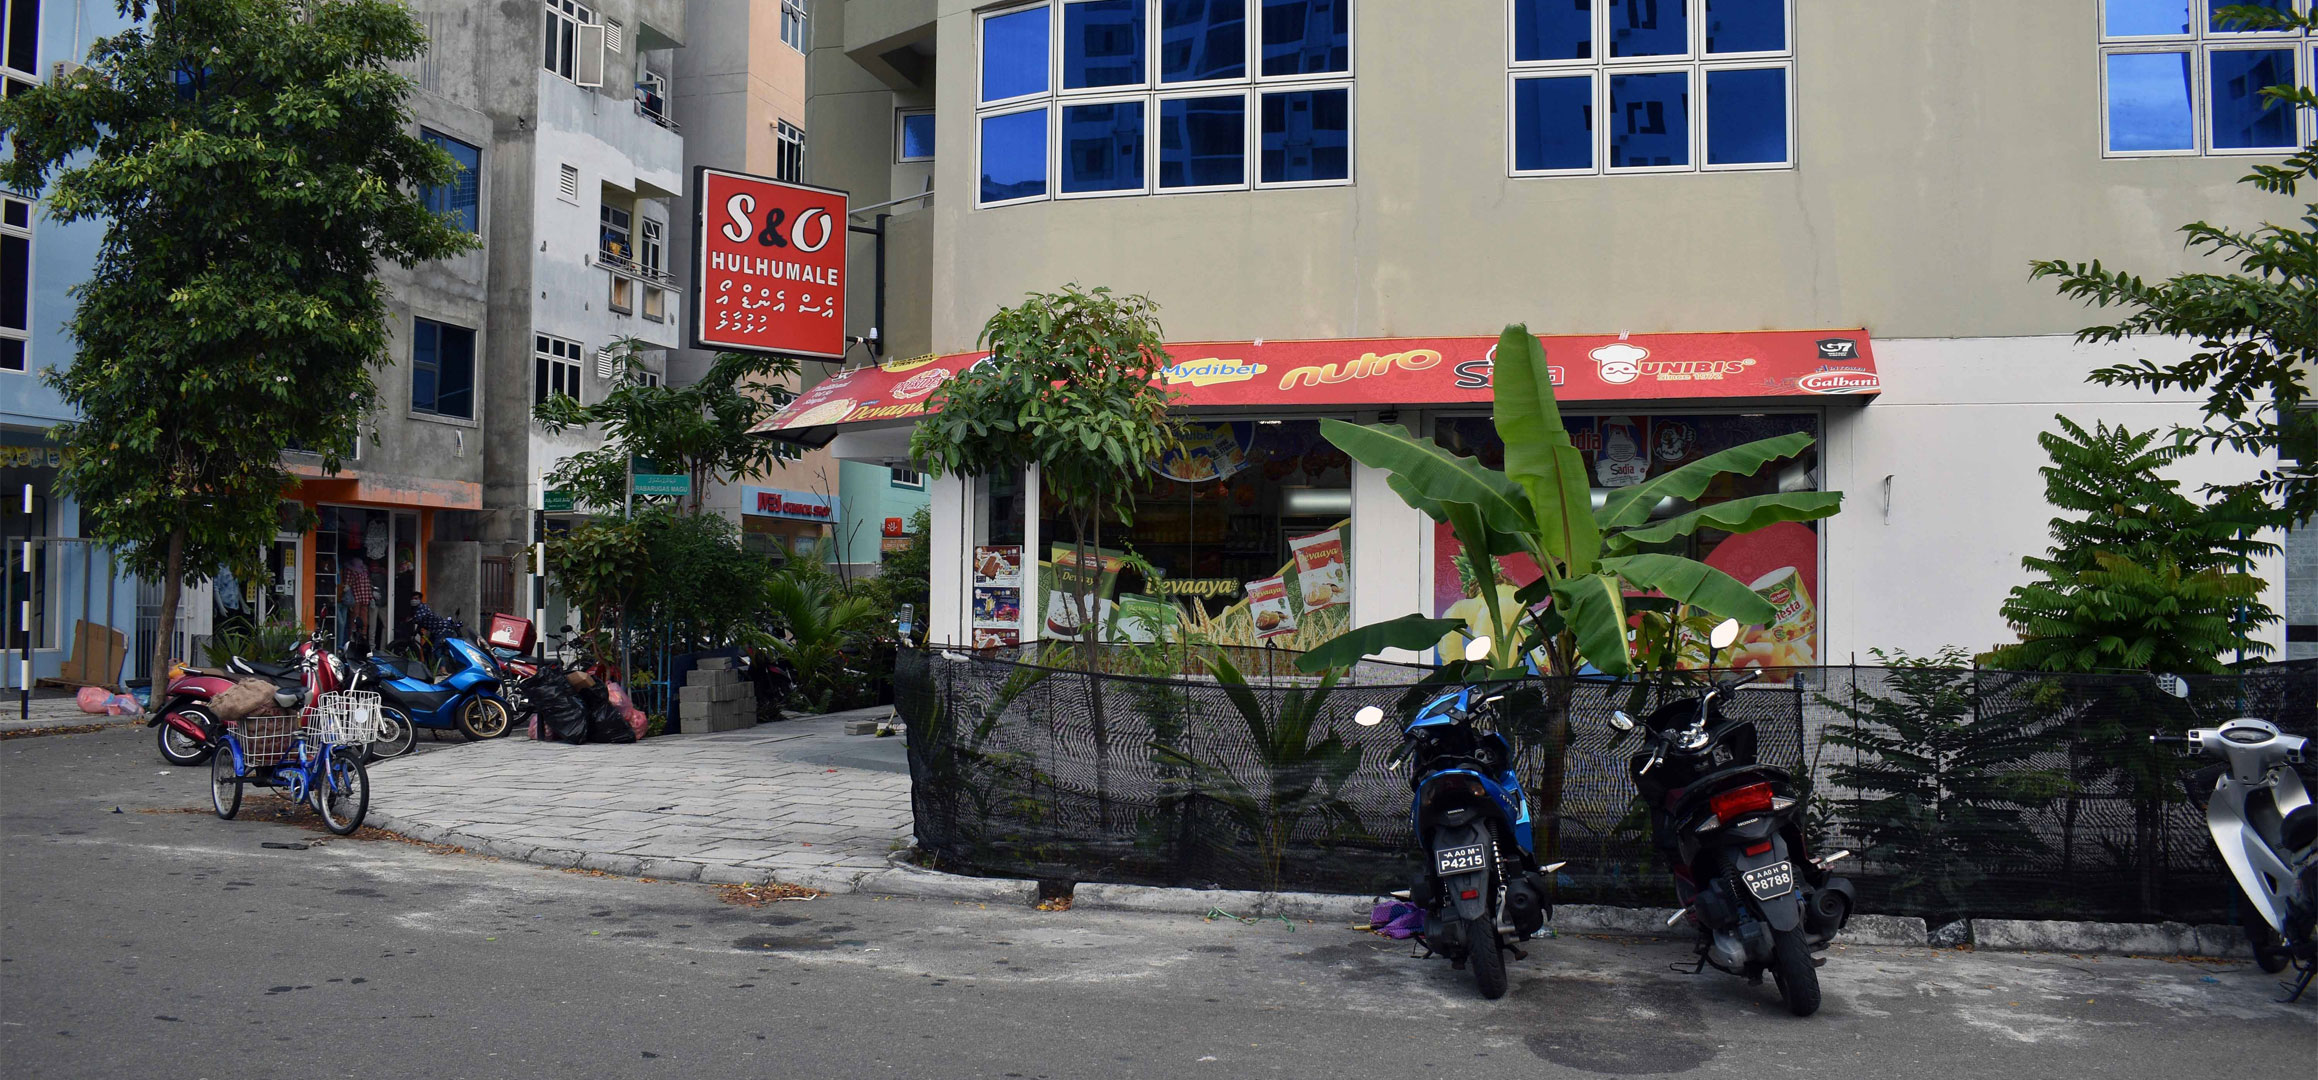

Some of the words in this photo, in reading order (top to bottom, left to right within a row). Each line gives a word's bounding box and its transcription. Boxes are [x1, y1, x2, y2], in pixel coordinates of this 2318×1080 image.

[712, 251, 838, 287] HULHUMALE
[1160, 363, 1259, 378] Mydibel
[1806, 376, 1877, 388] Galbani
[1610, 463, 1635, 475] Sadia
[671, 485, 688, 493] MAGU
[1775, 600, 1801, 621] iesta
[1737, 817, 1759, 827] HONDA
[1441, 855, 1483, 870] P4215
[1751, 873, 1790, 893] P8788
